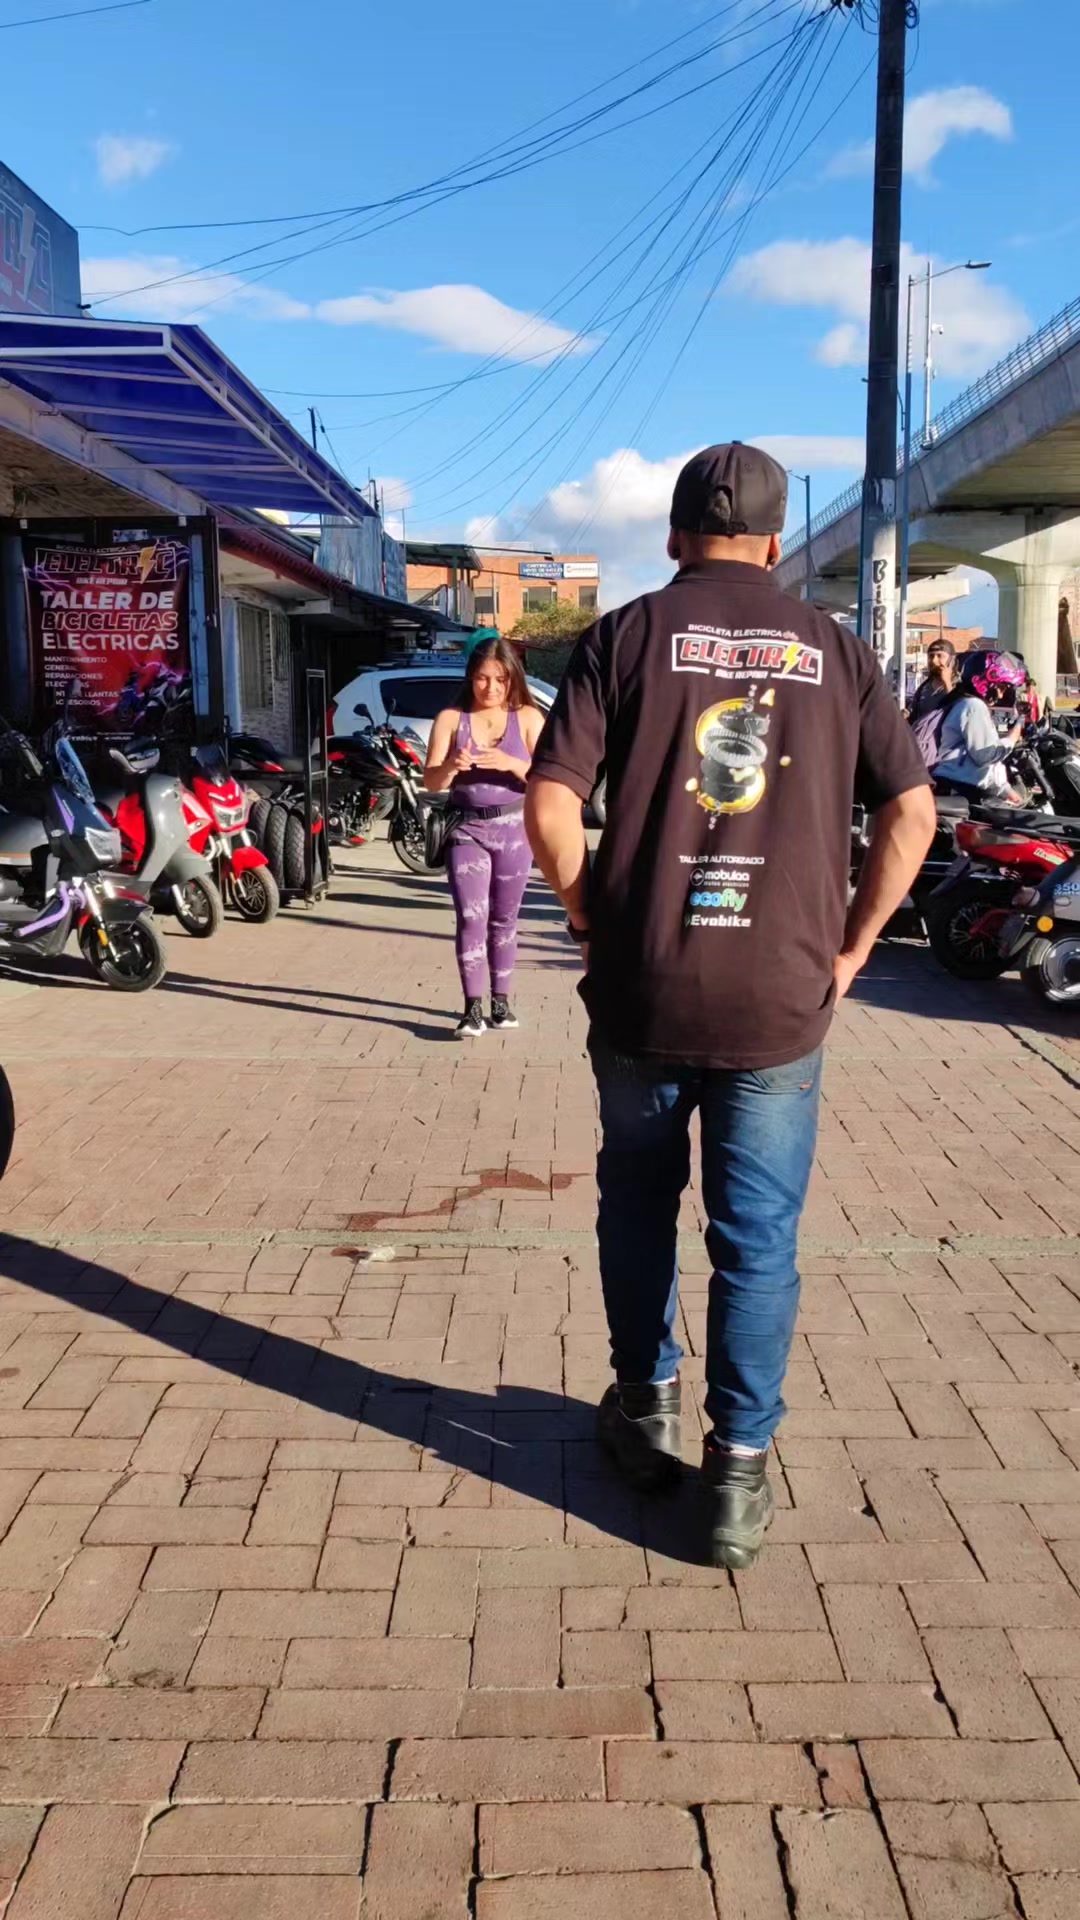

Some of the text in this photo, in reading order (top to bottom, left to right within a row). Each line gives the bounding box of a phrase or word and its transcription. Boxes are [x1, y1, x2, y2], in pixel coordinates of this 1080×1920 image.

[40, 591, 175, 610] TALLER DE
[41, 611, 179, 632] BICICLETAS
[688, 624, 782, 637] BICICLETA ELECTRICA
[42, 633, 179, 650] ELECTRICAS
[679, 855, 765, 865] TALLER AUTORIZADO
[690, 888, 747, 912] ecofly
